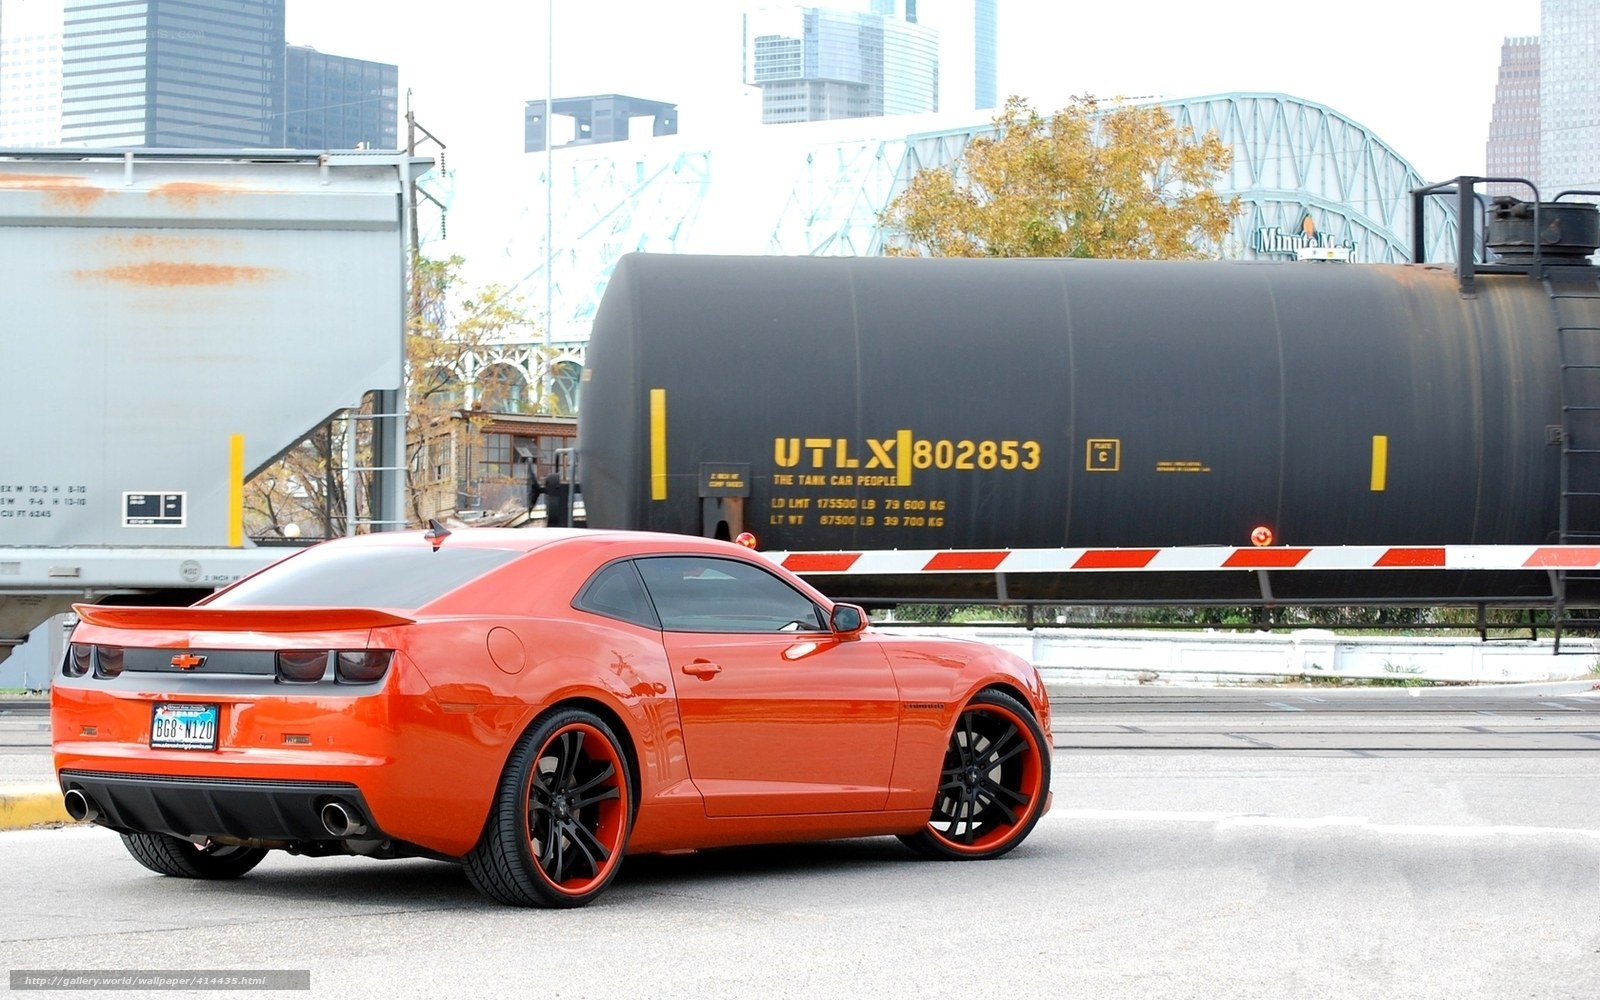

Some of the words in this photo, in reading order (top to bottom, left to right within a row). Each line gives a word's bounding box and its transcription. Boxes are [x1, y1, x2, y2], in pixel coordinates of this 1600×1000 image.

[1259, 227, 1318, 252] Minute
[774, 438, 897, 468] UTLX
[912, 440, 1040, 470] 802853
[1098, 451, 1108, 462] C
[773, 474, 794, 485] THE
[798, 475, 826, 486] TANK
[830, 475, 853, 486] CAR
[857, 475, 897, 487] PEOPLE
[771, 498, 785, 508] LD
[788, 498, 811, 509] LMT
[817, 498, 857, 509] 175500
[861, 499, 876, 510] LB
[885, 499, 900, 510] 79
[903, 500, 926, 510] 600
[930, 500, 946, 511] KG
[770, 515, 785, 525] LT
[788, 515, 804, 525] WT
[819, 515, 857, 525] 87500
[860, 516, 876, 526] LB
[883, 516, 899, 526] 39
[902, 516, 925, 527] 700
[928, 517, 945, 527] KG
[156, 719, 178, 738] BG8
[184, 720, 213, 740] N120
